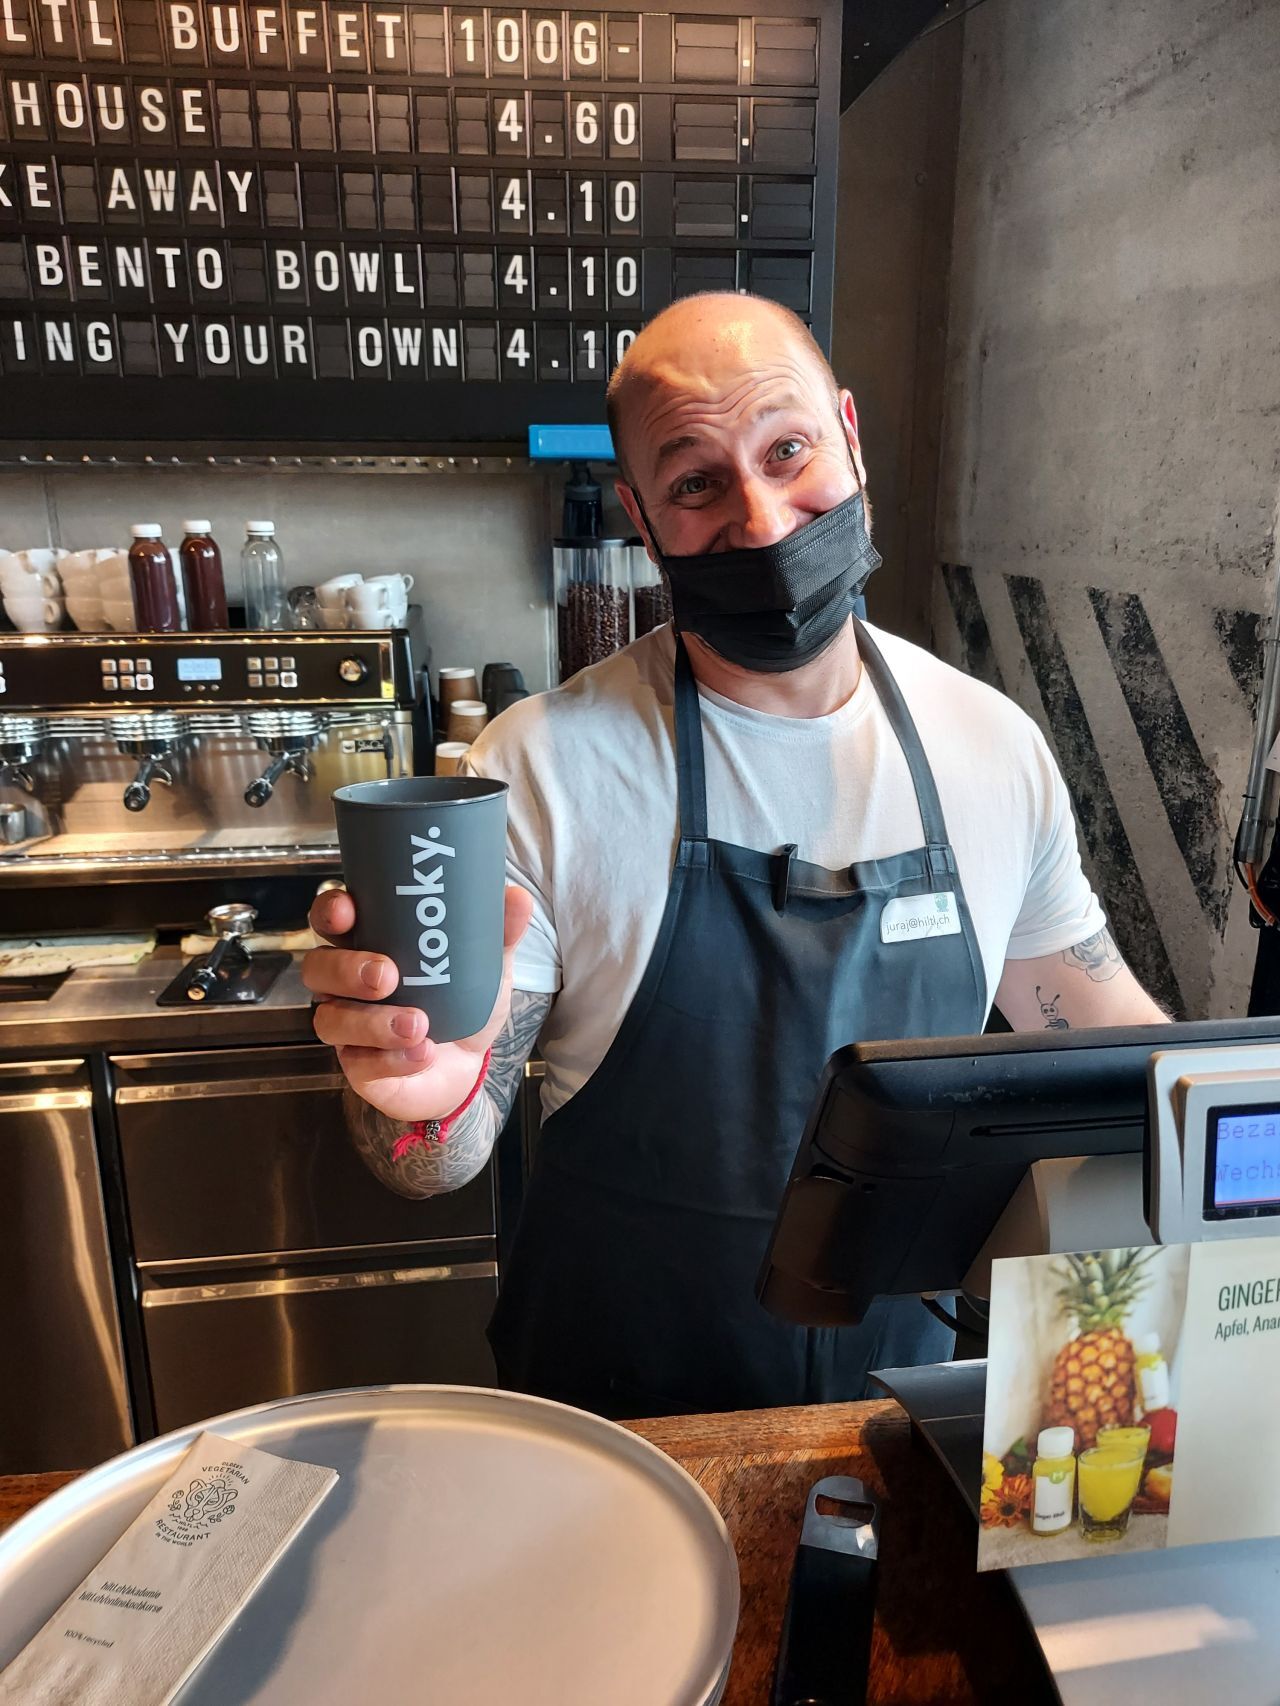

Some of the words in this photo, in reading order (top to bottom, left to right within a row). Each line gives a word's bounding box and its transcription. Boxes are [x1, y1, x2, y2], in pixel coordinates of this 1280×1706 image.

[3, 0, 113, 45] LTL
[172, 5, 401, 58] BUFFET
[11, 81, 206, 133] HOUSE
[498, 100, 636, 145] 4.60
[107, 168, 253, 213] AWAY
[501, 178, 636, 222] 4.10
[36, 245, 224, 290] BENTO
[276, 250, 415, 293] BOWL
[504, 255, 637, 297] 4.10
[13, 321, 113, 363] ING
[164, 323, 308, 364] YOUR
[358, 327, 458, 367] OWN
[395, 826, 456, 987] kooky.
[1217, 1122, 1280, 1140] Beza
[1214, 1317, 1250, 1342] Apfel,
[202, 1466, 250, 1485] VEGETARIAN
[155, 1519, 211, 1541] RESTAURANT
